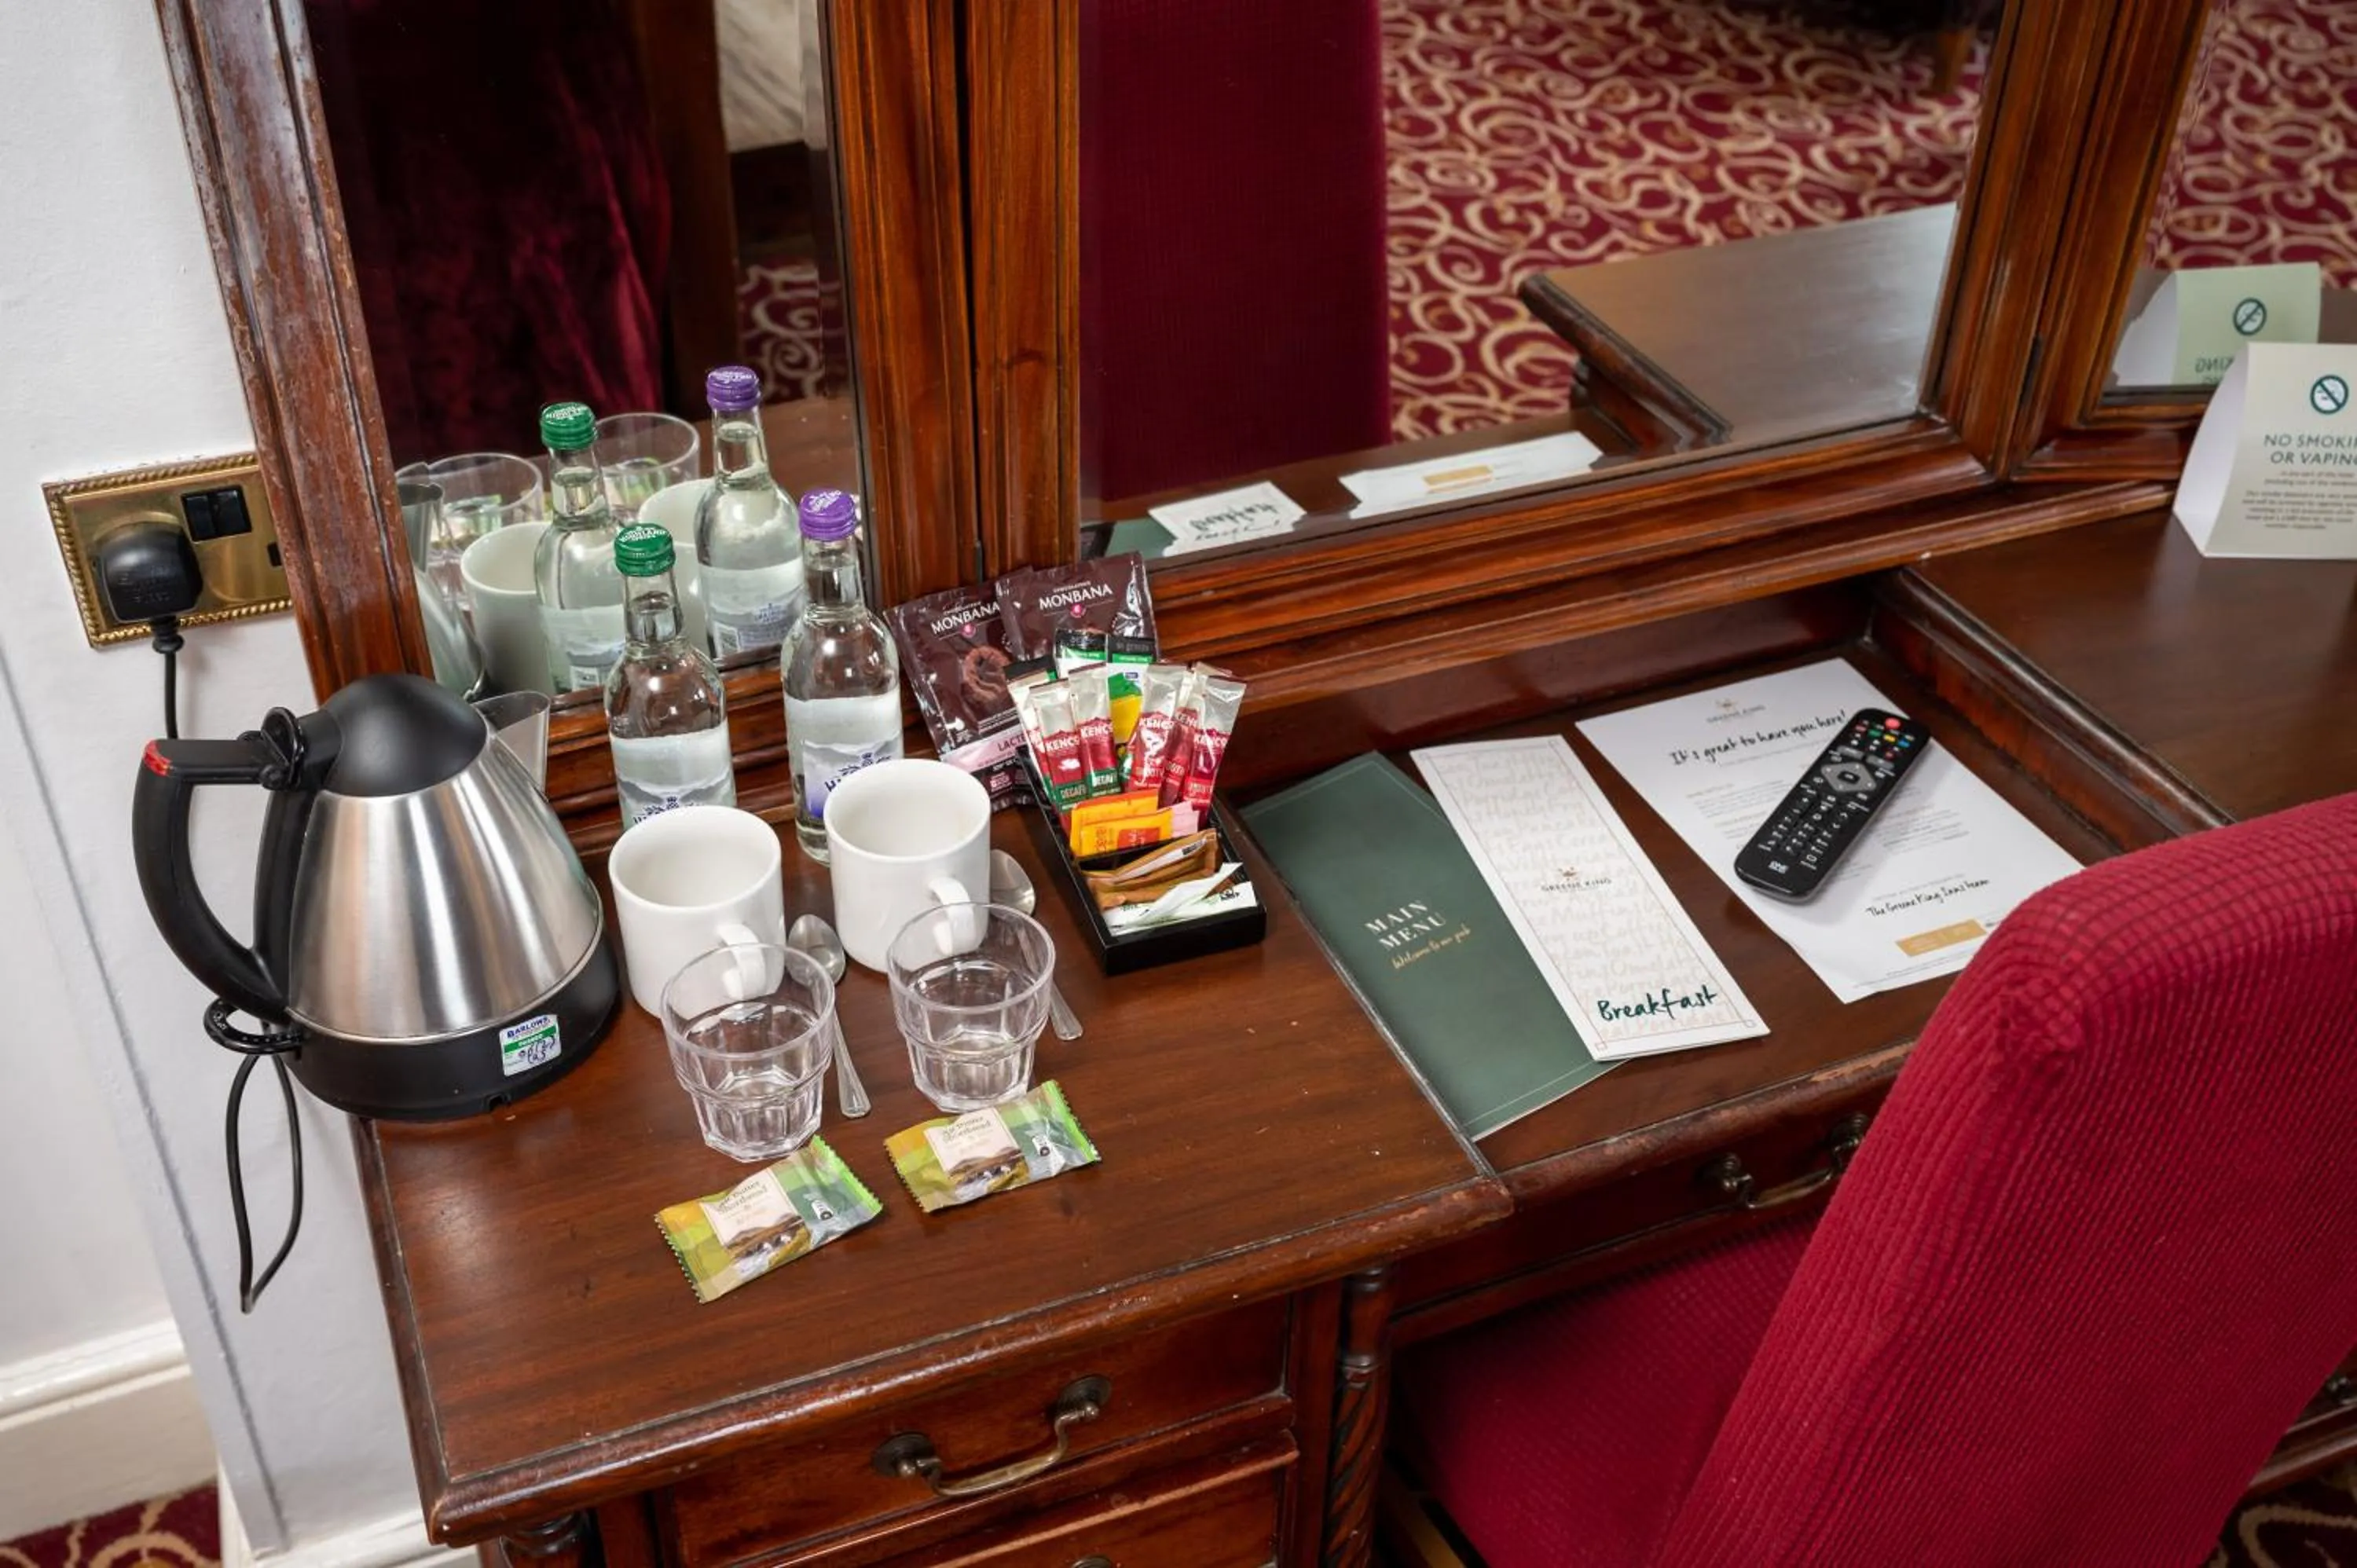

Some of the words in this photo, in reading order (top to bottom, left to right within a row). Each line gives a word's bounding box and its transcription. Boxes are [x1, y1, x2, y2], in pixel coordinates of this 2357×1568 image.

[2264, 434, 2292, 447] NO
[2297, 434, 2357, 449] SMOKI
[2271, 451, 2294, 464] OR
[1039, 584, 1114, 610] MONBANA
[930, 600, 1000, 635] MONBANA
[1703, 737, 1737, 764] great
[1739, 735, 1756, 747] to
[1756, 731, 1787, 742] have
[1364, 900, 1428, 935] MAIN
[1865, 907, 1886, 917] The
[1379, 912, 1446, 951] MENU
[1597, 984, 1717, 1020] Breakfast
